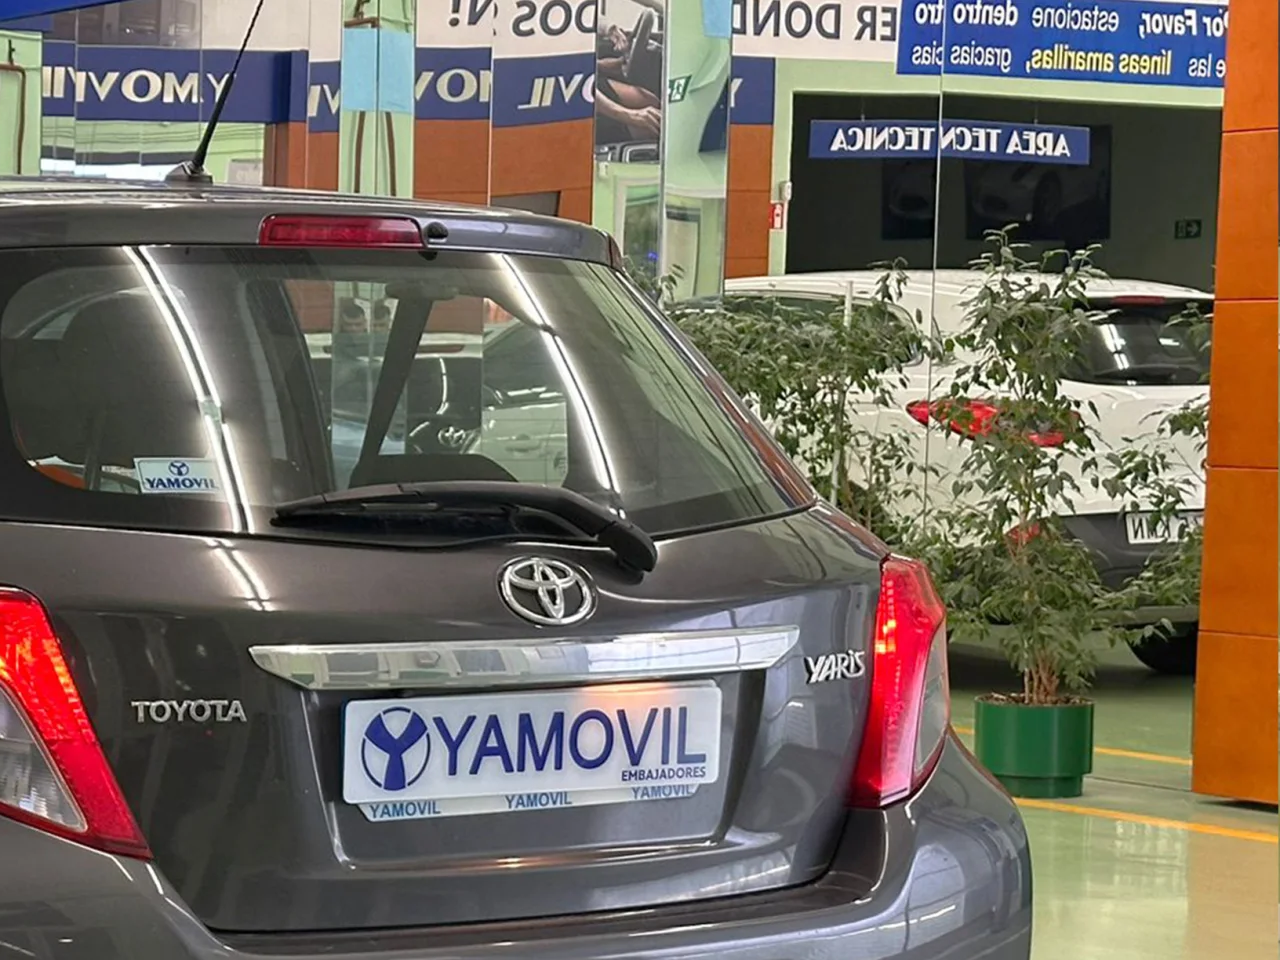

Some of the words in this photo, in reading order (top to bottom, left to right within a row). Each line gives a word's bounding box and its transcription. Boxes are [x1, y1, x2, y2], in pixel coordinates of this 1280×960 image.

[145, 477, 219, 489] YAMOVIL
[131, 699, 247, 722] TOYOTA
[432, 706, 707, 776] YAMOVIL
[621, 766, 706, 782] EMBAJADORES
[369, 801, 441, 820] YAMOVIL
[505, 791, 573, 810] YAMOVIL
[631, 784, 693, 799] YAMOVIL
